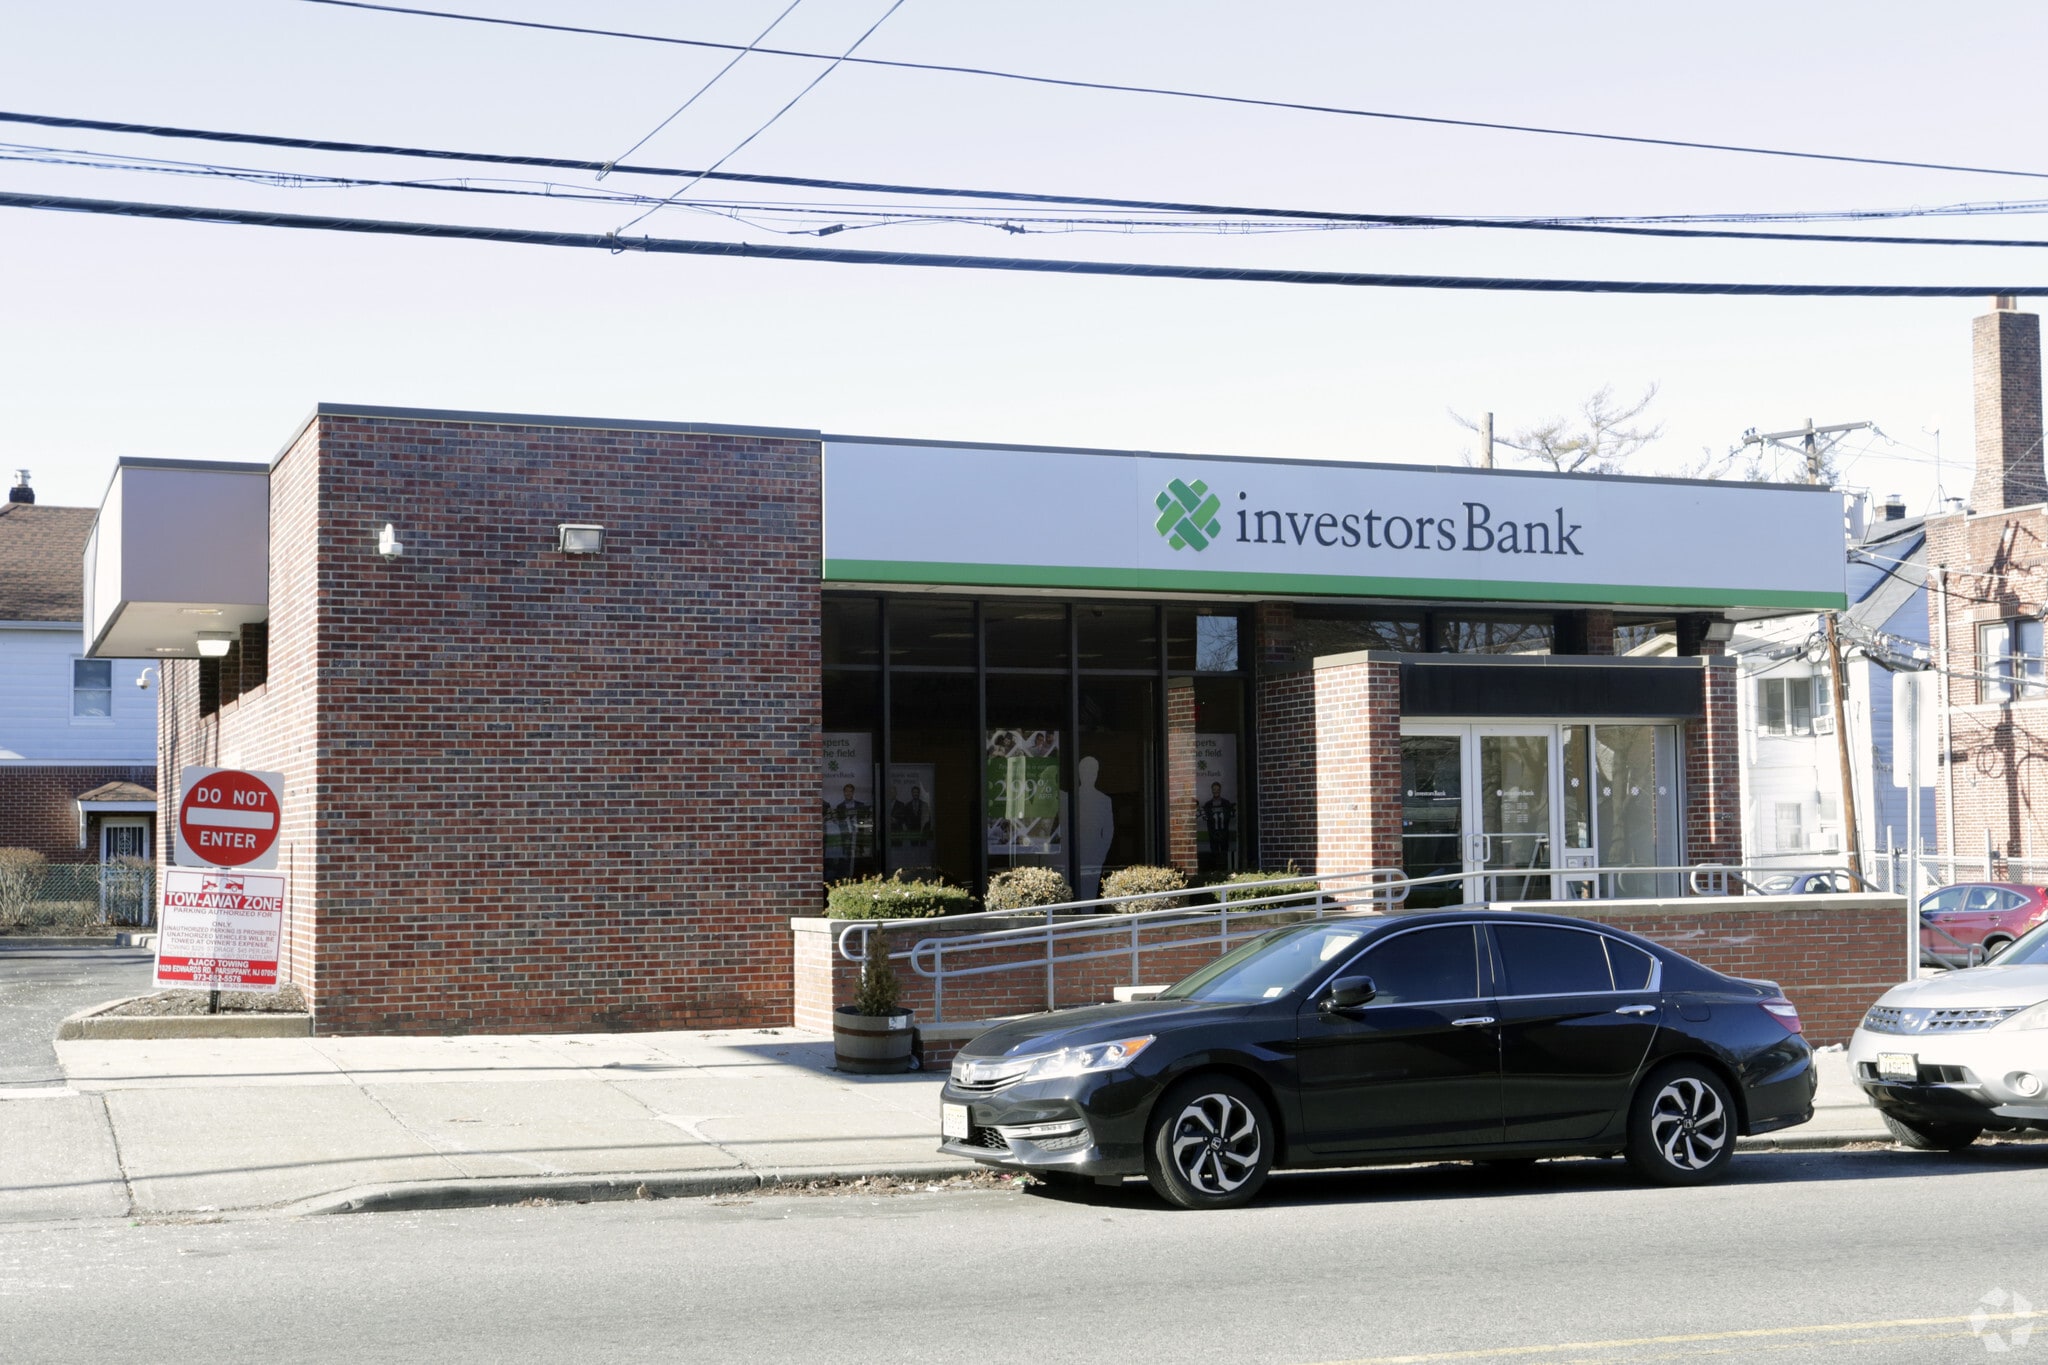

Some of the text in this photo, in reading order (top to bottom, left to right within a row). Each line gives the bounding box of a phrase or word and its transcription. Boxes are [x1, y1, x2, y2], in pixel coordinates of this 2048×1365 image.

[1236, 491, 1584, 556] investorsBank
[197, 787, 268, 807] DO NOT
[200, 830, 257, 849] ENTER
[166, 891, 282, 911] TOW-AWAY ZONE
[173, 907, 207, 915] PARKING
[208, 909, 256, 917] AUTHORIZED
[172, 965, 202, 973] EDWARDS
[252, 968, 260, 976] NJ
[188, 958, 249, 968] AJACO TOWING
